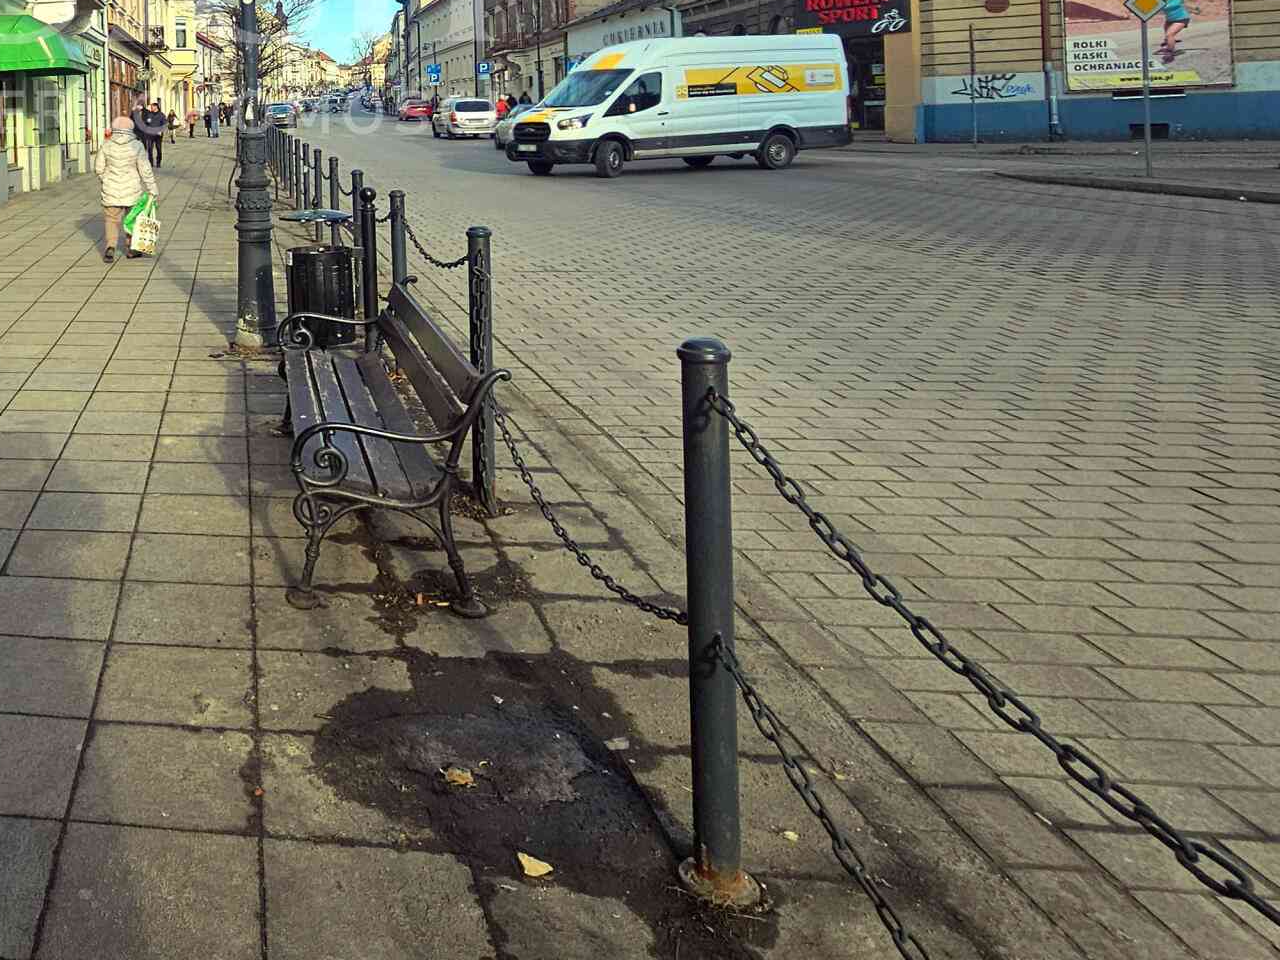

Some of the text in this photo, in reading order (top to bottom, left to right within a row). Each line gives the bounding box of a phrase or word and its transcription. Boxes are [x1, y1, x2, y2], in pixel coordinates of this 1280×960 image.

[818, 4, 881, 24] SPORT
[1073, 40, 1107, 49] ROLKI
[1073, 52, 1108, 61] KASKI
[479, 63, 489, 73] P
[1074, 60, 1154, 71] OCHRANIACE
[429, 74, 438, 82] P
